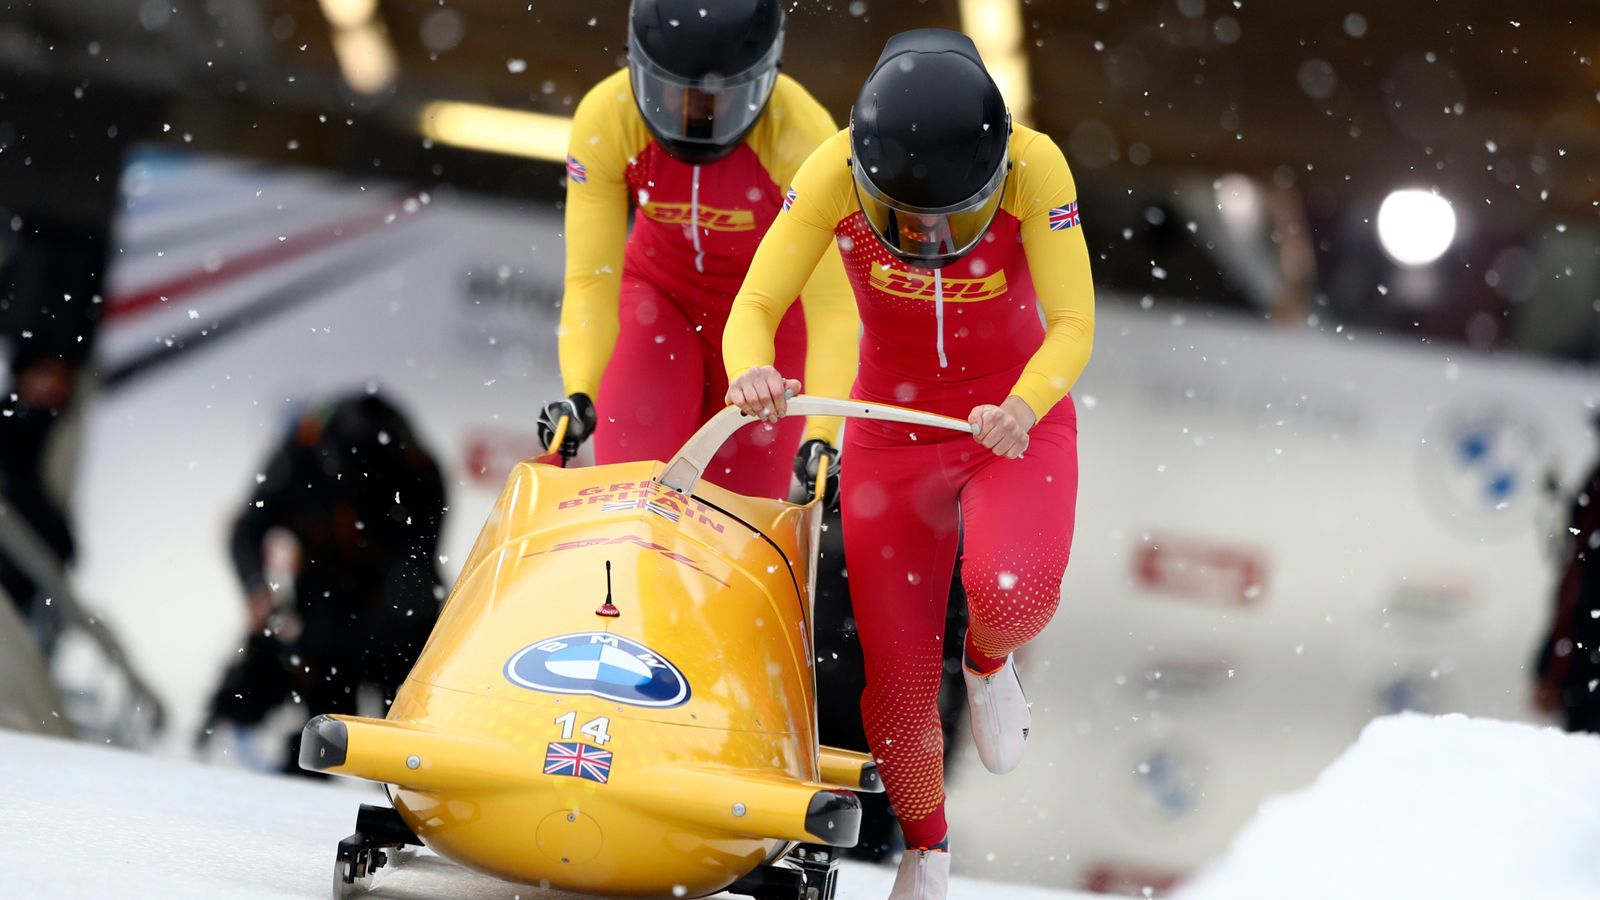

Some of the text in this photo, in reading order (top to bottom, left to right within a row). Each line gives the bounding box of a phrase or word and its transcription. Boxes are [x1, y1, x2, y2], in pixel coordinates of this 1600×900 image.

[654, 207, 738, 228] DHL
[885, 273, 993, 299] DHL
[558, 489, 725, 534] BRITAIN
[578, 480, 713, 513] GREAT
[538, 635, 667, 669] BMW
[554, 711, 611, 745] 14
